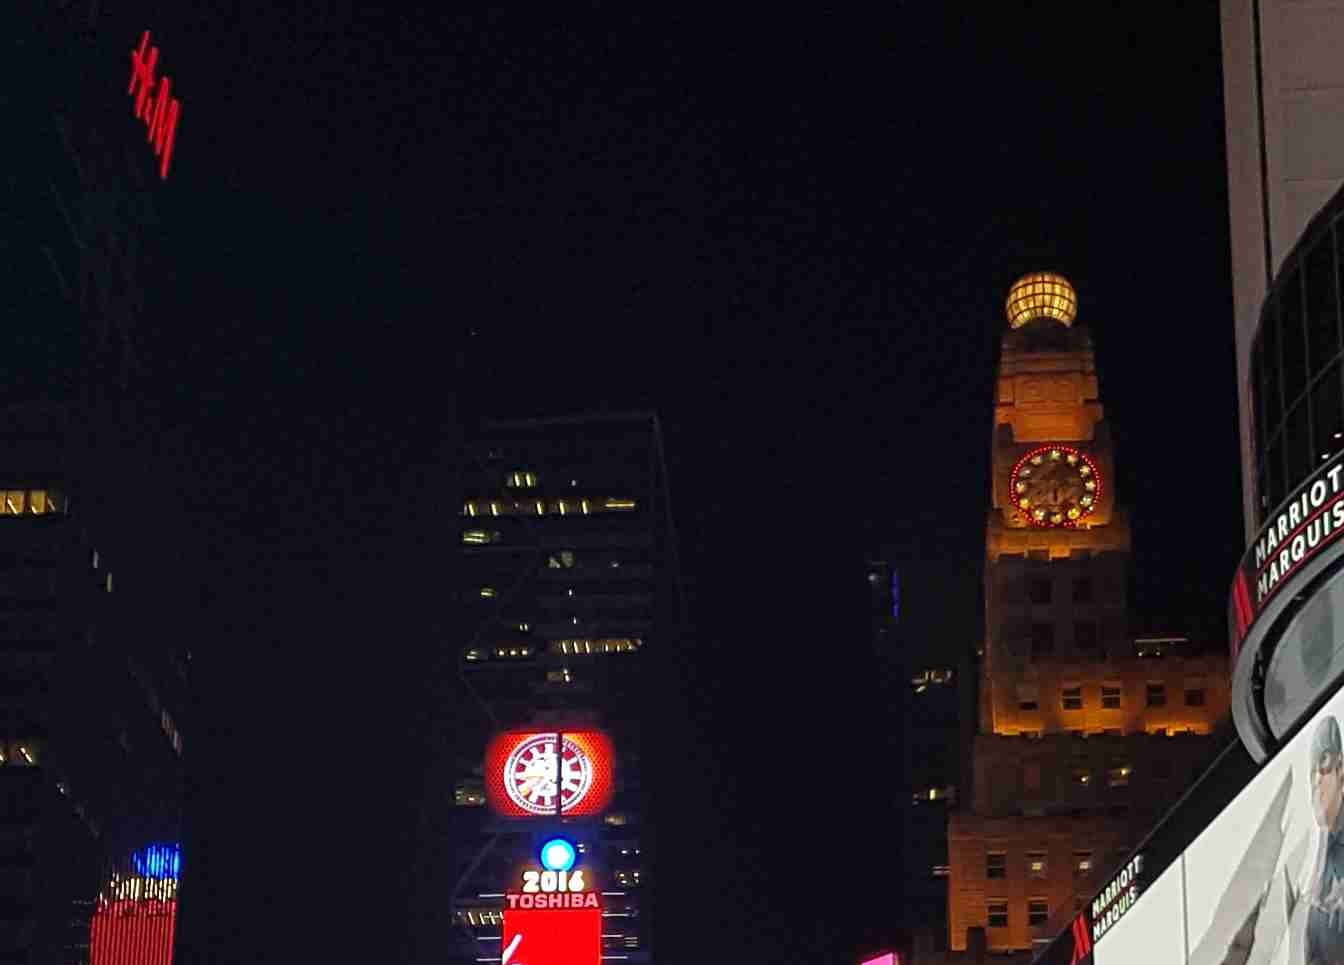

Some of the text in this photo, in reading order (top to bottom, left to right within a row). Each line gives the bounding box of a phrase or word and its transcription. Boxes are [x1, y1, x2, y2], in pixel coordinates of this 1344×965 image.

[129, 29, 179, 180] H&M
[506, 892, 599, 909] TOSHIBA
[522, 869, 585, 893] 2016
[1092, 855, 1144, 917] MARRIOTT
[1092, 887, 1138, 943] MARQUIS
